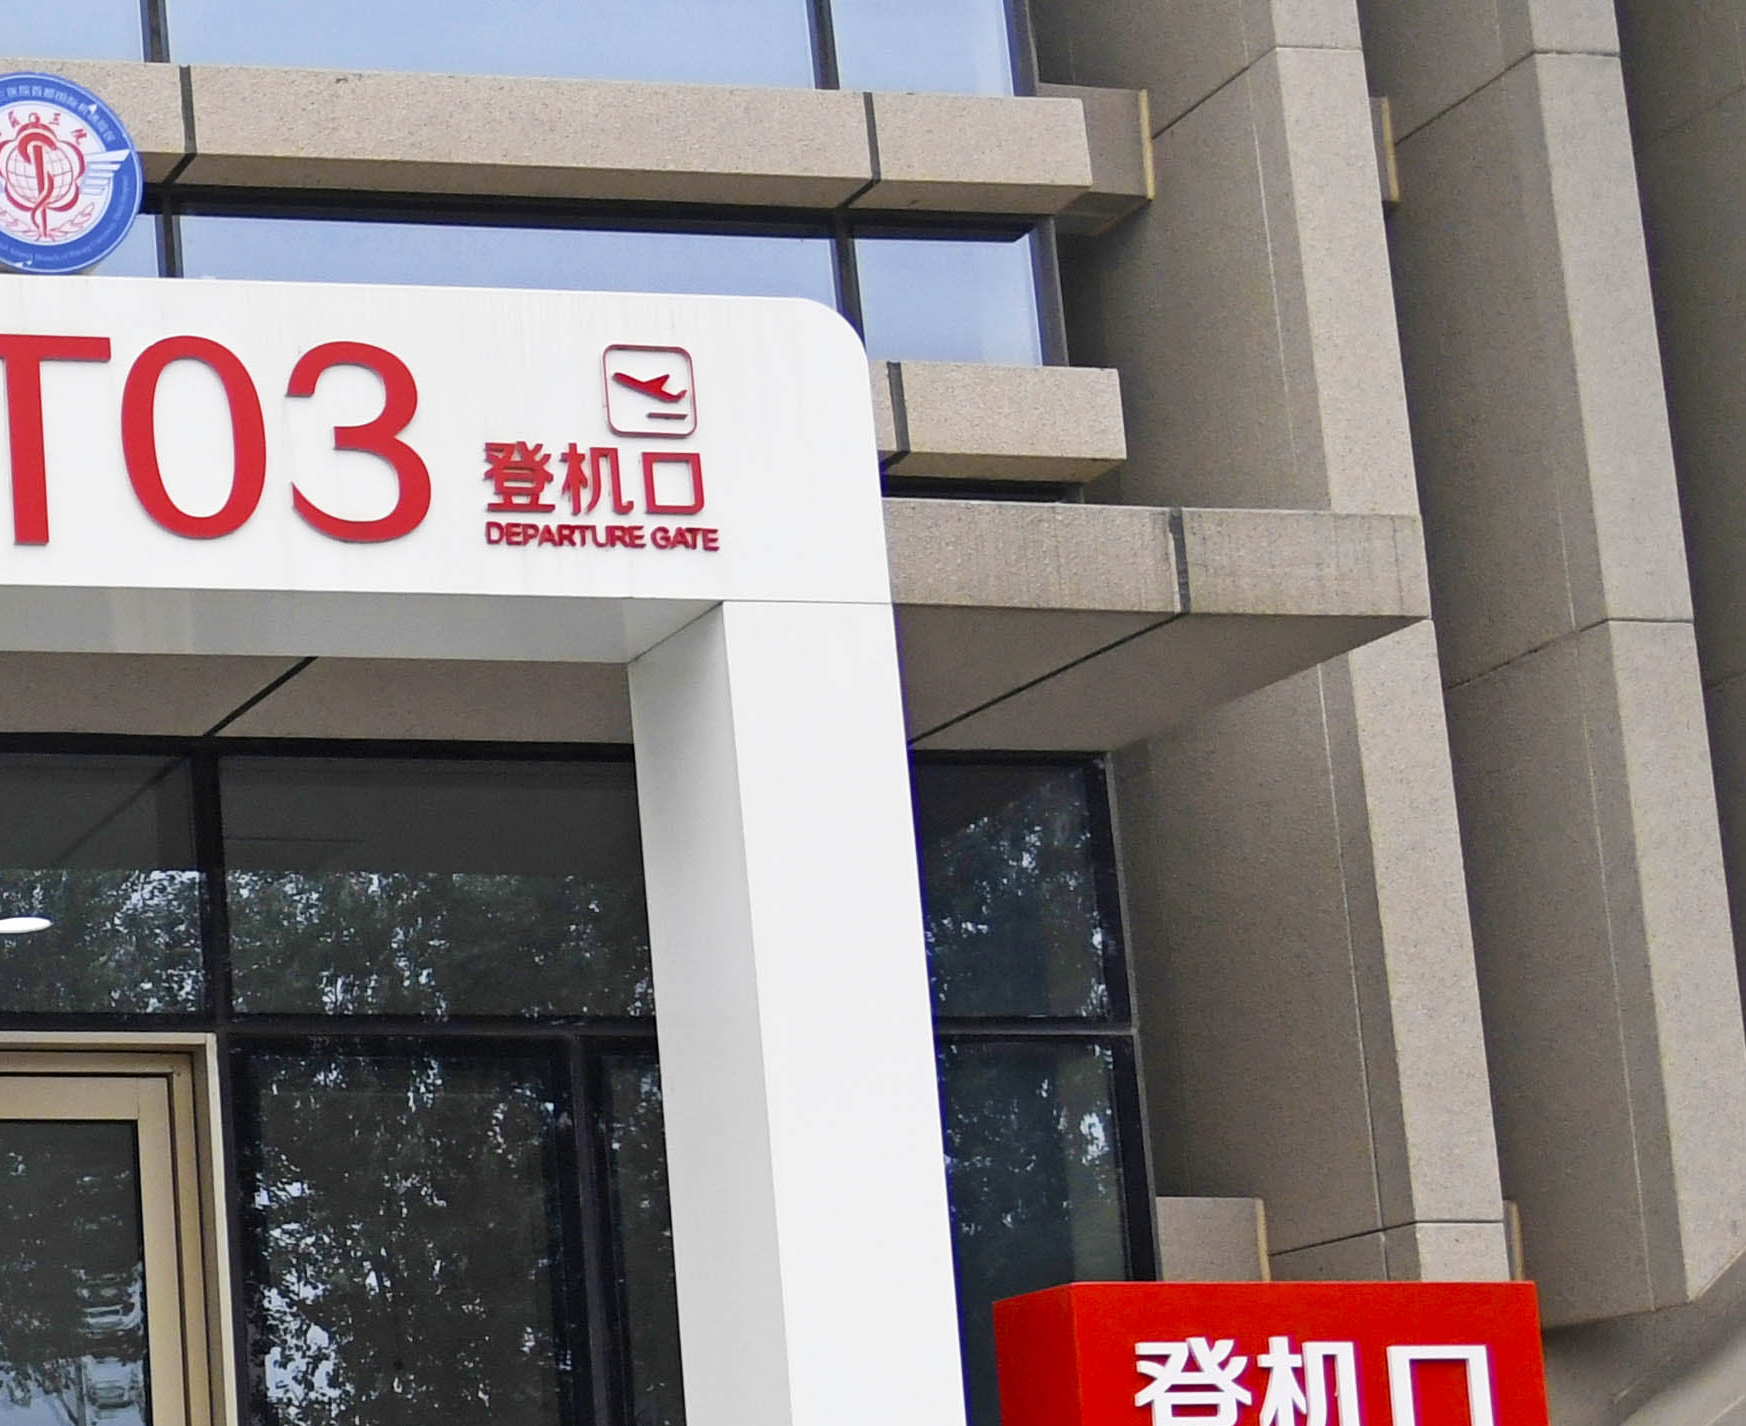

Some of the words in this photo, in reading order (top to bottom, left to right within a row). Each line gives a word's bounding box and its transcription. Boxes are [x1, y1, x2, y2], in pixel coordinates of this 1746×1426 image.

[484, 440, 705, 516] 登机口
[486, 522, 646, 548] DEPARTURE
[651, 527, 719, 552] GATE
